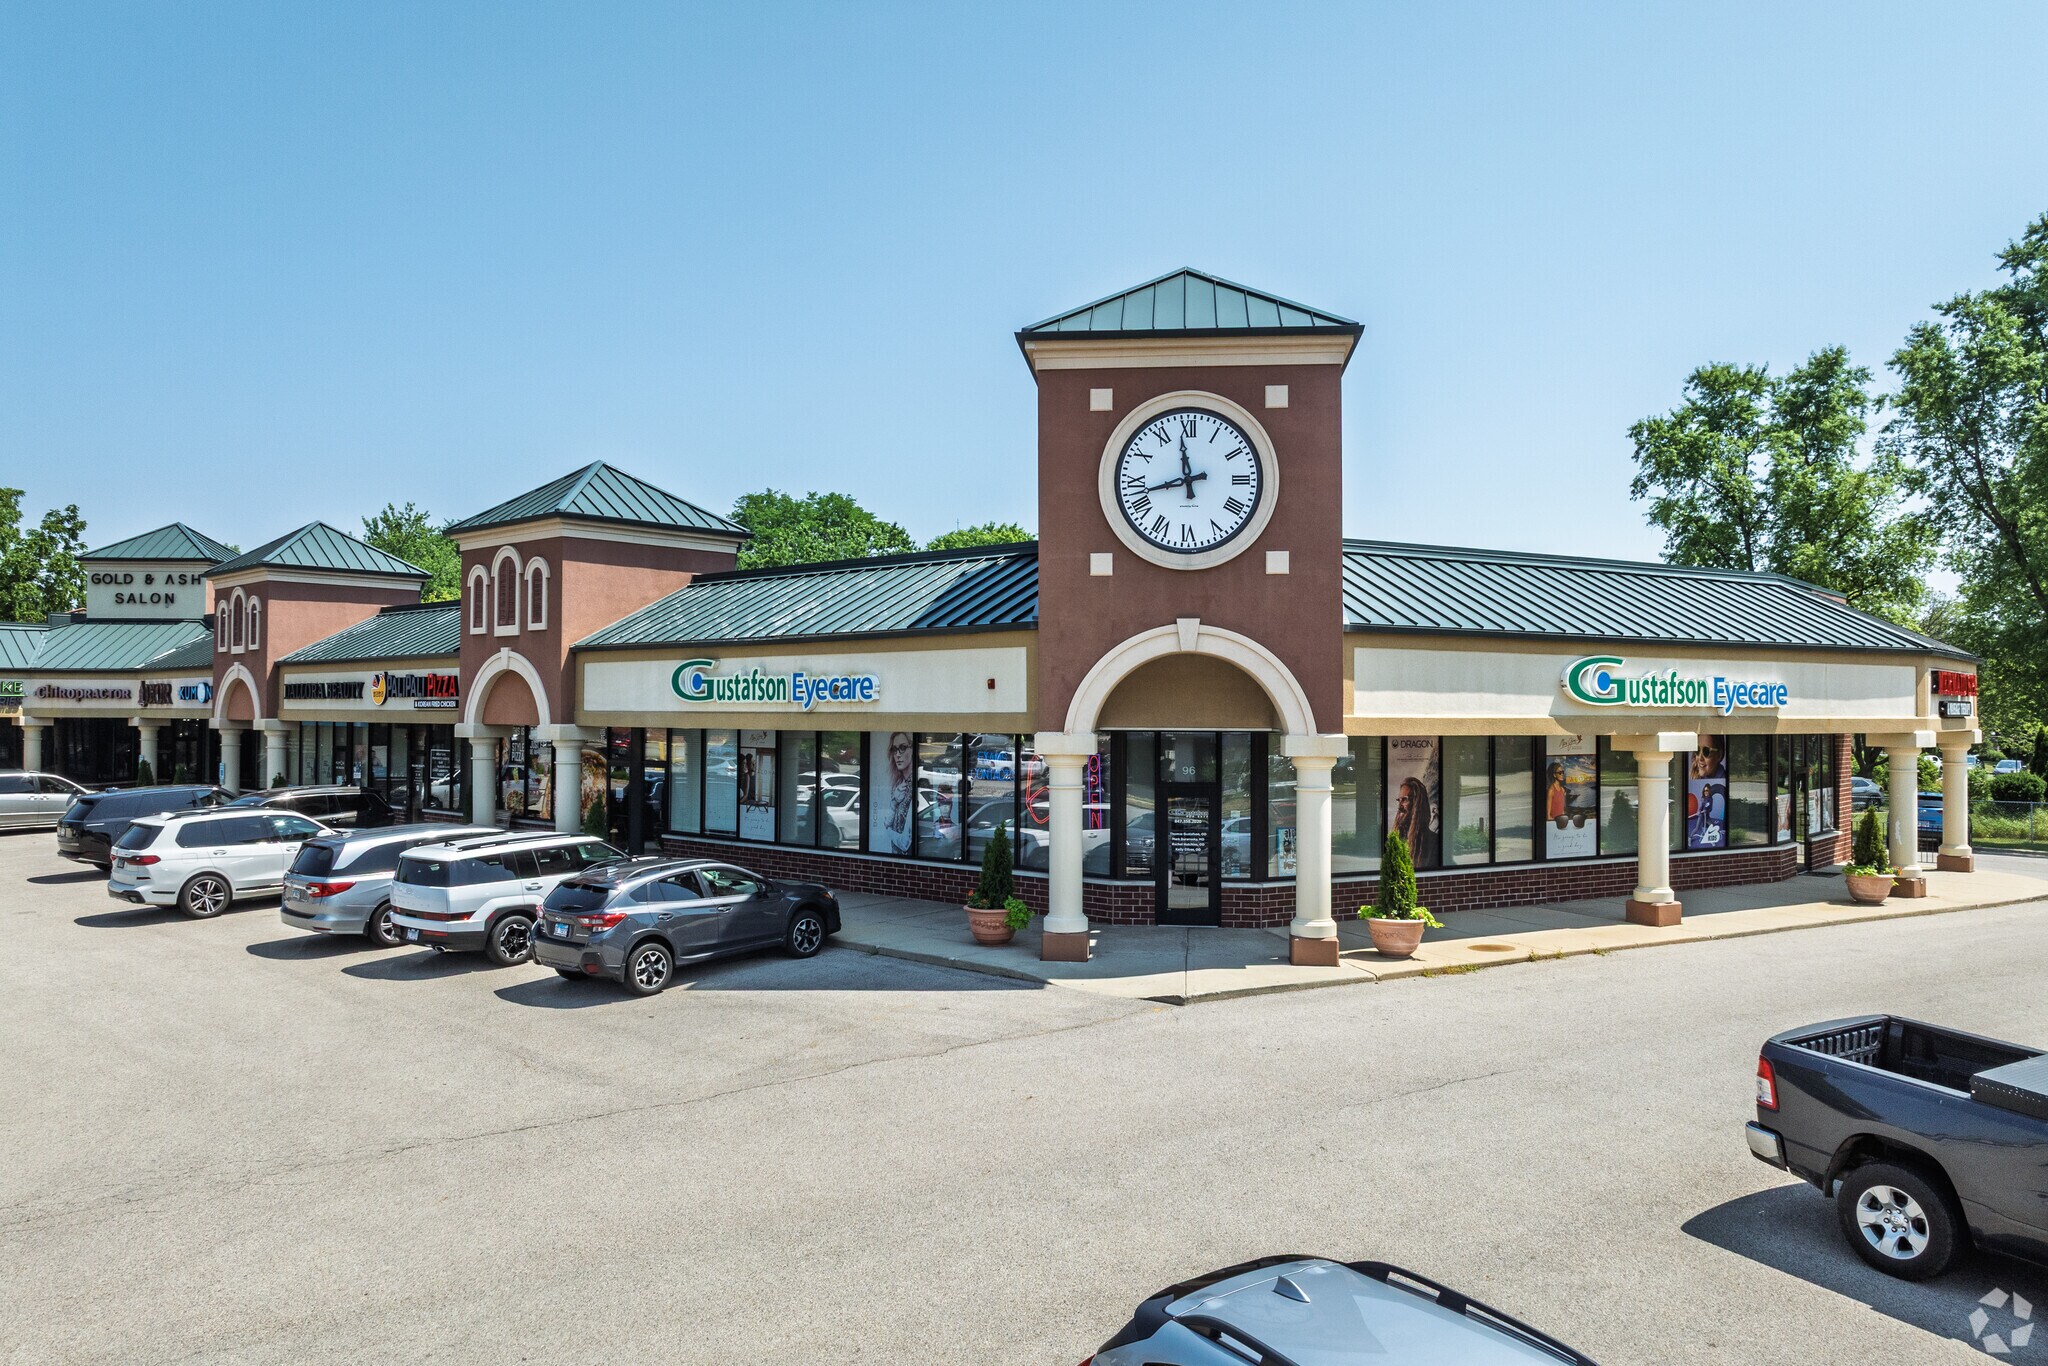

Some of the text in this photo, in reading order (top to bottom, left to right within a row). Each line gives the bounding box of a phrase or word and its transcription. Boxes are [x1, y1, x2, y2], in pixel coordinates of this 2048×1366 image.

[91, 573, 201, 585] GOLD & ASH
[114, 592, 175, 604] SALON
[178, 681, 212, 704] KUMON
[326, 682, 365, 699] BEAUTY
[427, 672, 457, 698] PIZZA
[671, 659, 874, 709] Gustafson Eyecare
[1568, 657, 1788, 714] Gustafson Eyecare
[1400, 739, 1434, 749] DRAGON
[1181, 765, 1196, 776] 96
[1089, 755, 1101, 830] OPEN
